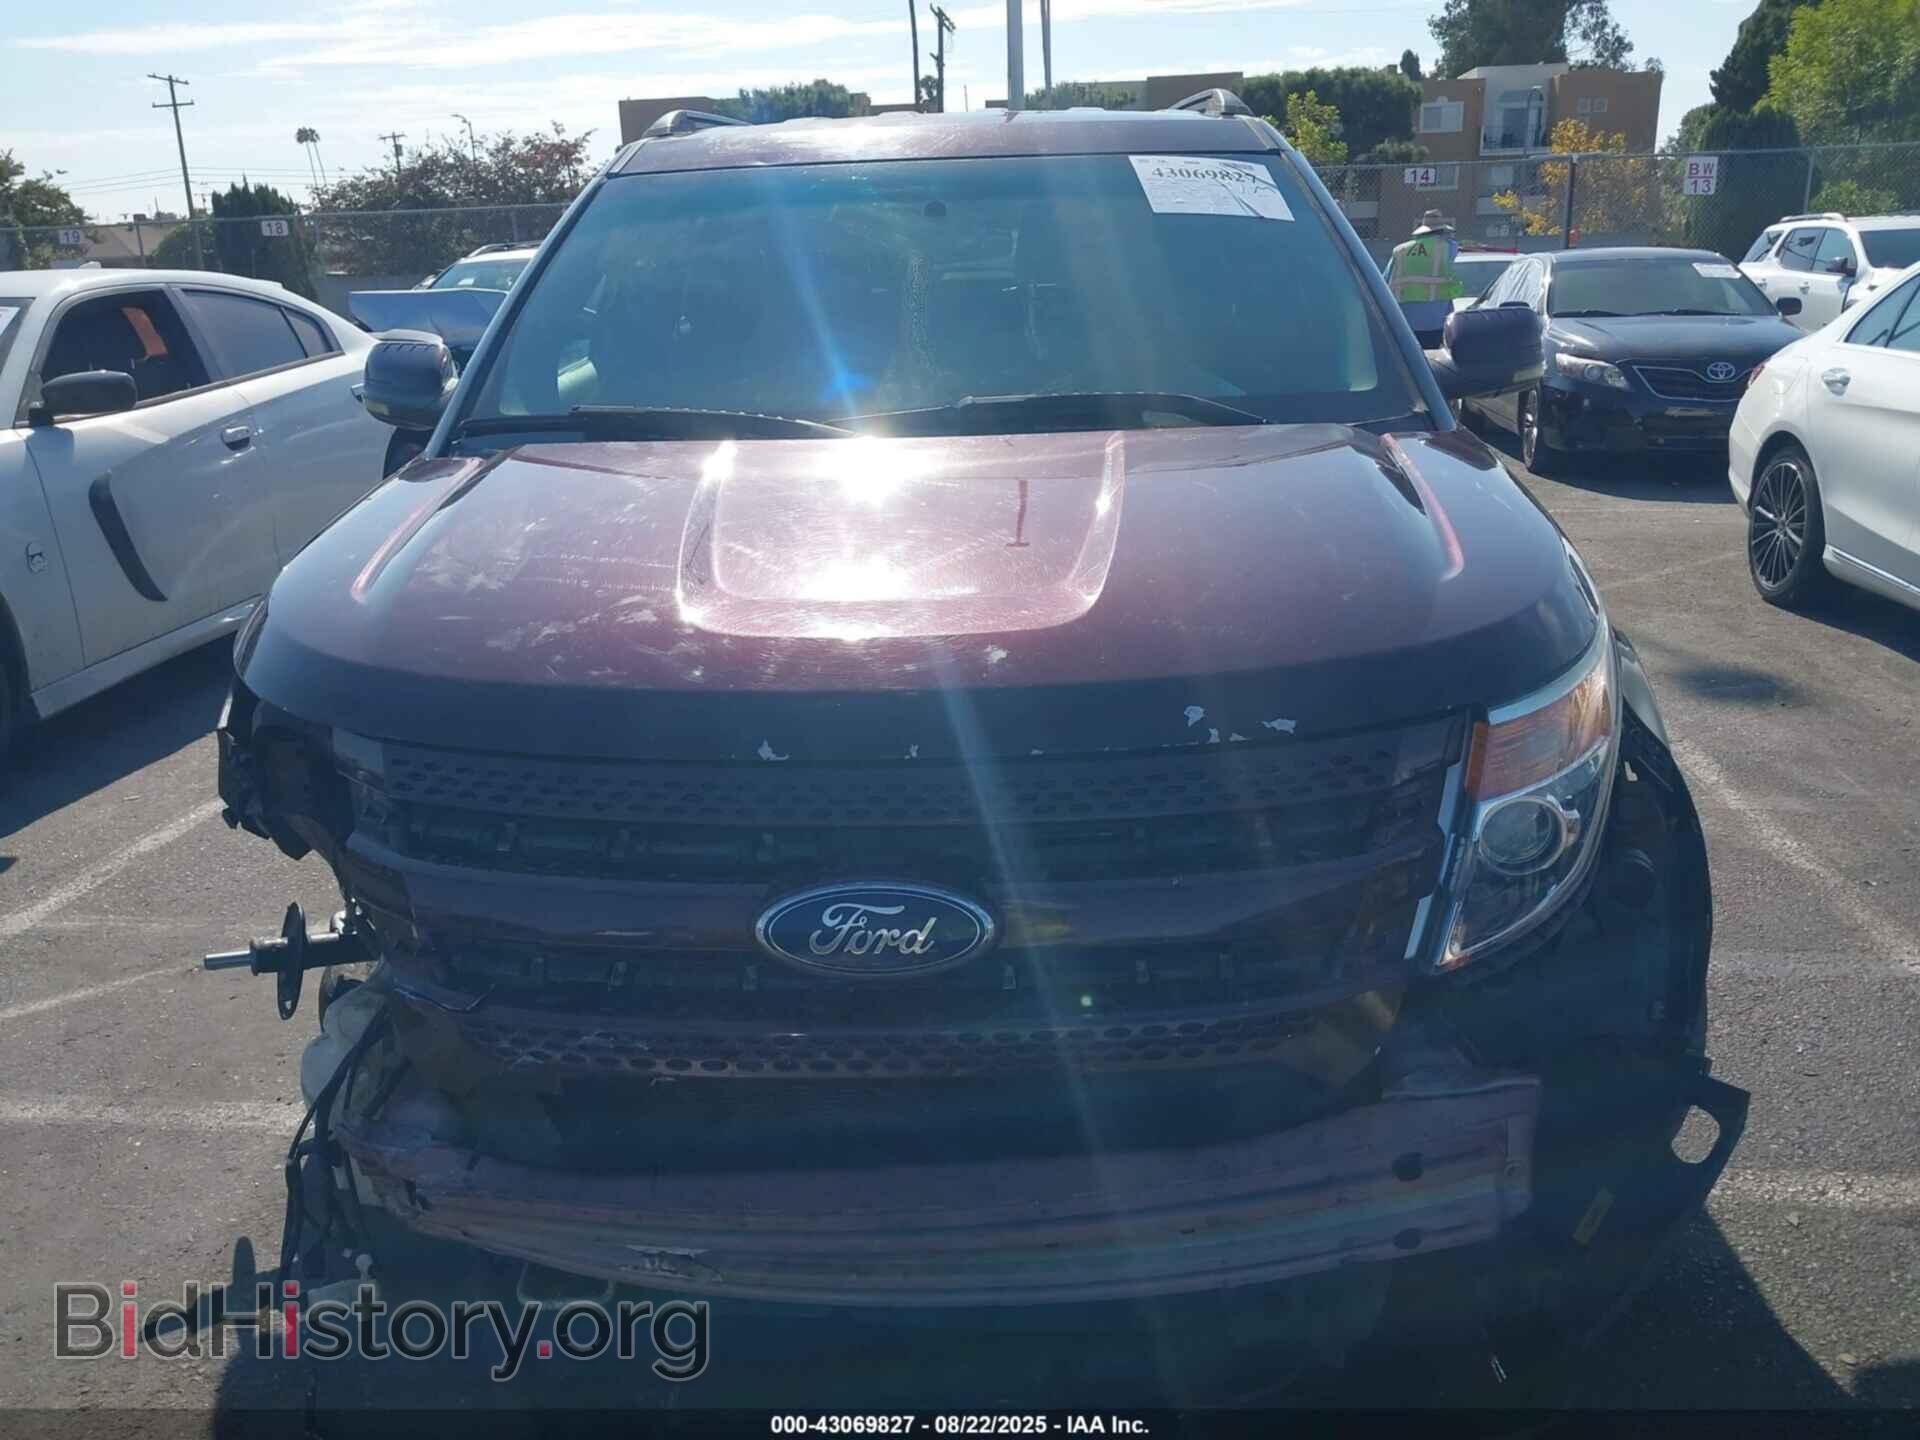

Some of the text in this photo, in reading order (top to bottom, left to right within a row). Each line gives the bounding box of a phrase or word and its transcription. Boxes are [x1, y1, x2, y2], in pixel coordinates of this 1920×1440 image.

[1152, 167, 1257, 184] 43069827
[1411, 169, 1430, 182] 14
[1691, 180, 1711, 193] 13
[266, 222, 284, 234] 18
[64, 230, 80, 242] 19
[809, 903, 937, 955] Ford
